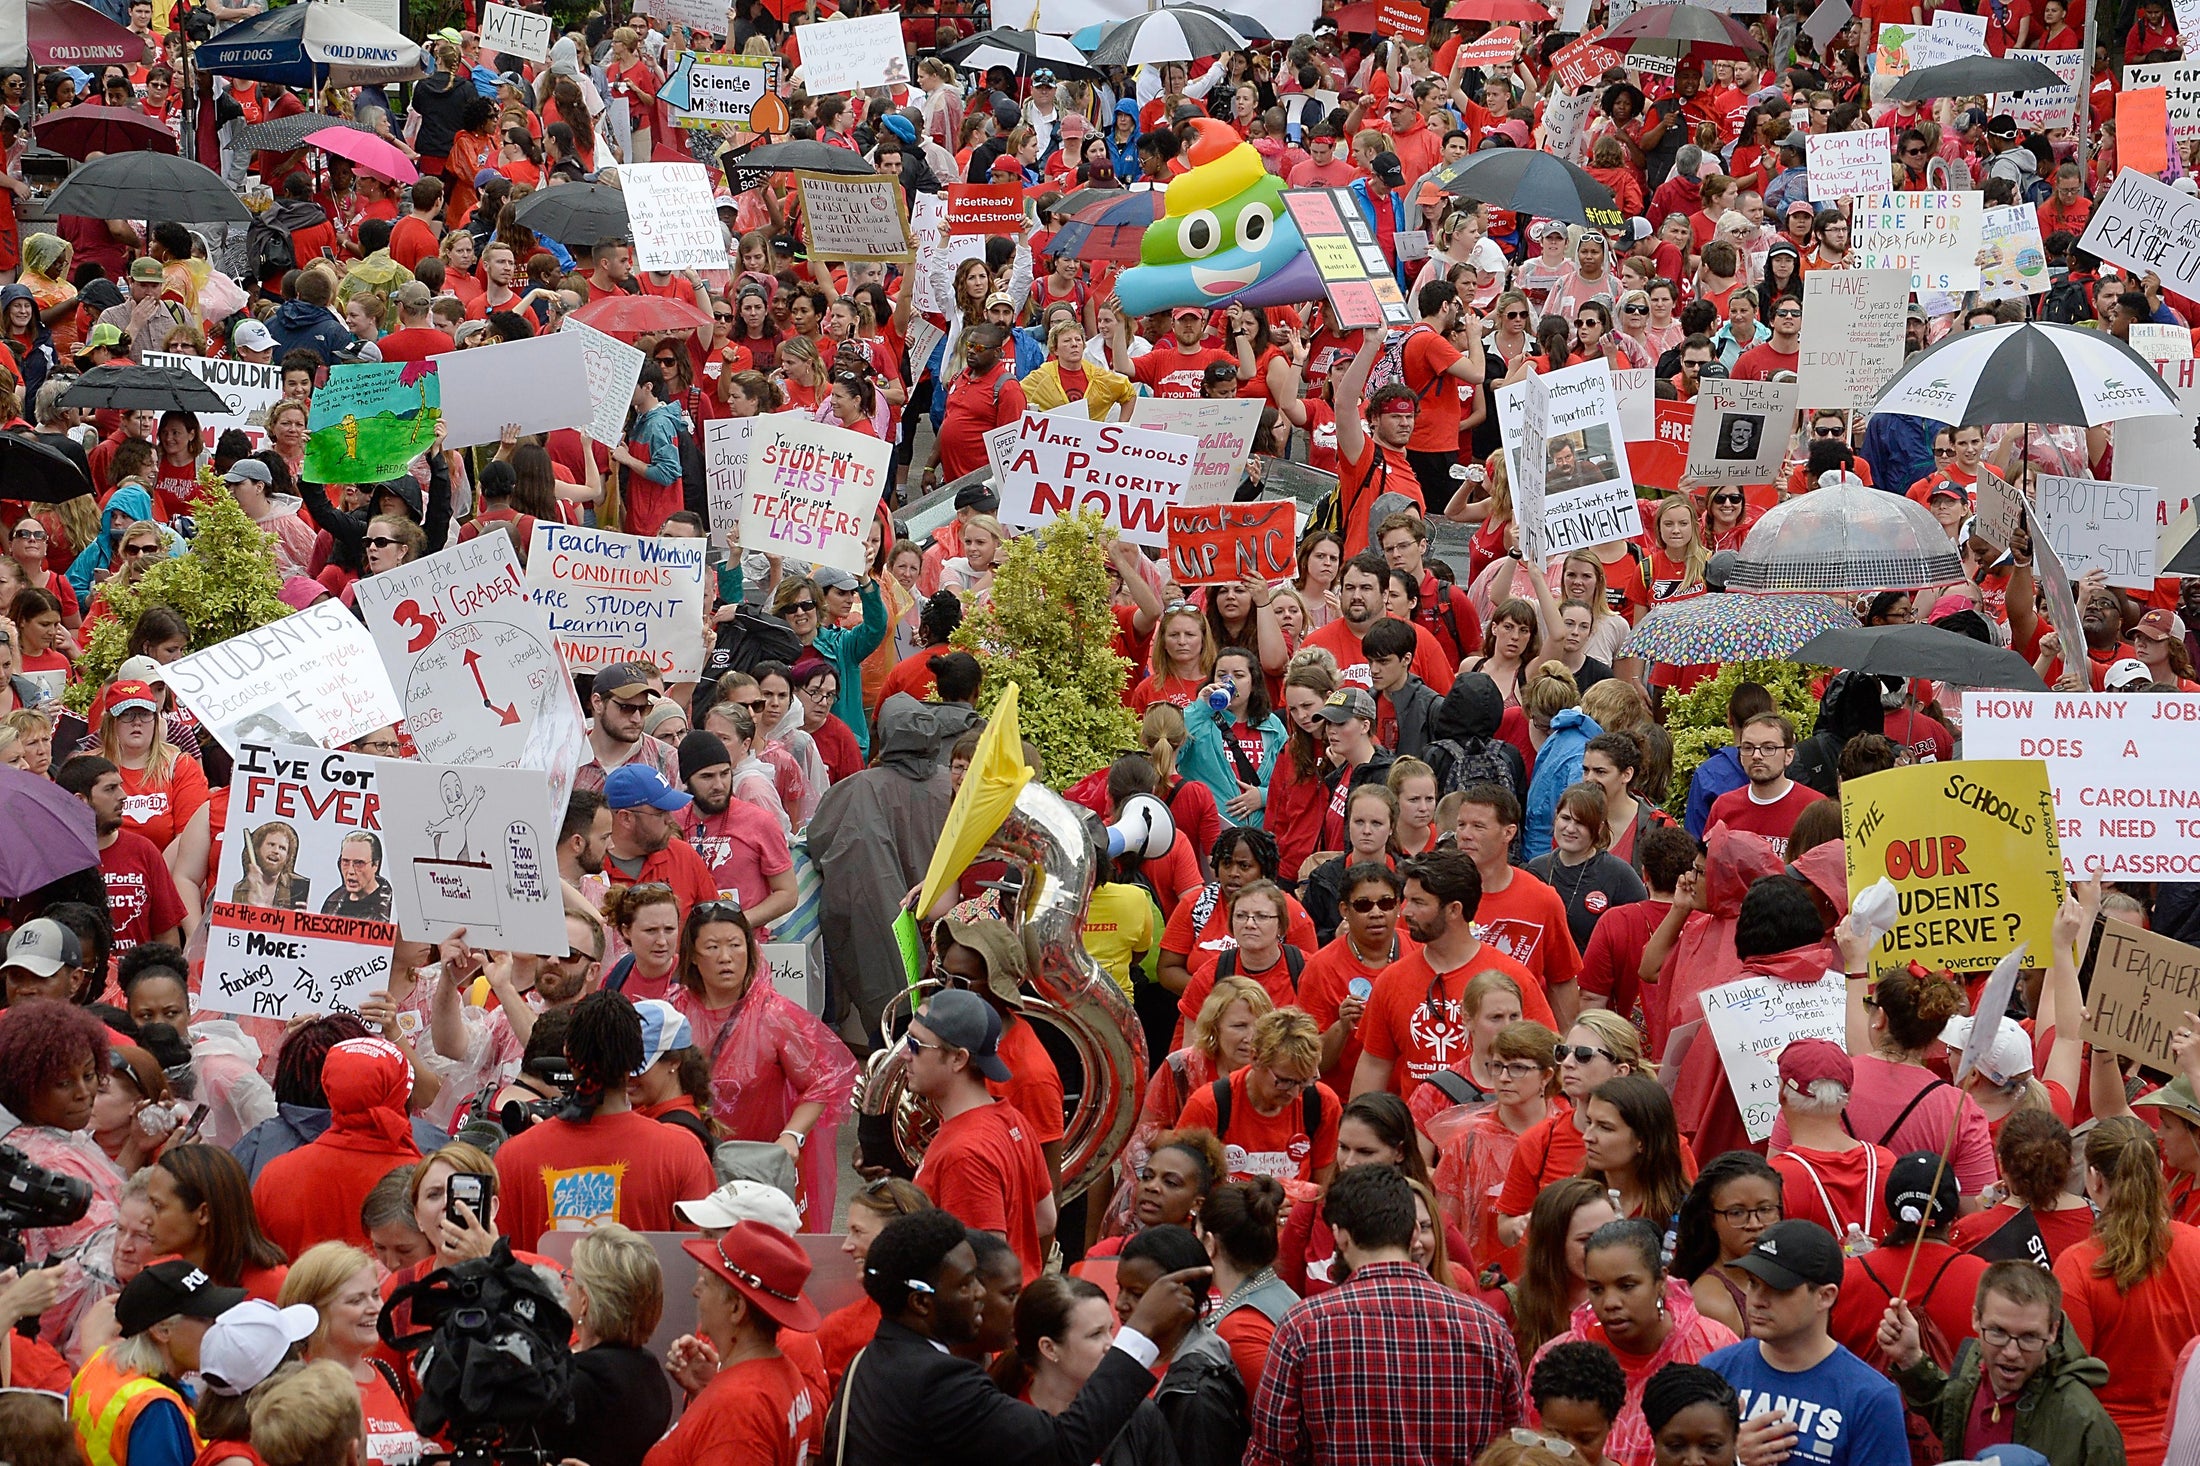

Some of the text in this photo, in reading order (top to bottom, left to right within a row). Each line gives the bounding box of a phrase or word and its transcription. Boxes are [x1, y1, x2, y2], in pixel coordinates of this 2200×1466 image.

[489, 8, 548, 40] WTF?
[1383, 5, 1422, 23] #GetReady
[843, 20, 892, 36] Professor
[1378, 15, 1425, 36] #NCAEStrong
[50, 45, 124, 59] COLD DRINKS
[219, 48, 273, 62] HOT DOGS
[323, 44, 398, 62] COLD DRINKS
[1462, 49, 1515, 59] #NCAEStrong
[2055, 54, 2080, 65] JUDGE
[808, 63, 830, 76] had
[1558, 53, 1616, 88] HAVE JOB
[2130, 69, 2161, 84] You
[2034, 97, 2054, 106] YEAR
[2001, 108, 2067, 122] CLASSROOM
[1807, 133, 1888, 154] I can afford
[1818, 153, 1876, 167] to teach
[621, 165, 705, 184] Your CHILD
[1809, 169, 1855, 181] because
[651, 190, 713, 206] TEACHER
[835, 183, 887, 194] CAROLINA
[1817, 180, 1858, 196] husband
[955, 198, 1014, 207] #GetReady
[1855, 194, 1962, 209] TEACHERS
[2112, 178, 2168, 220] NORTH
[637, 215, 721, 236] 3 LIVE
[842, 214, 861, 224] TAX
[950, 212, 1022, 223] #NCAEStrong
[1585, 207, 1624, 225] #ForOur
[1854, 214, 1960, 230] HERE FOR
[652, 230, 715, 246] #TIRED
[2139, 219, 2196, 249] C'MON AND
[1852, 254, 1920, 270] GRADE
[1809, 277, 1870, 296] I HAVE:
[1870, 295, 1905, 312] years of
[1859, 311, 1899, 321] experience
[1883, 320, 1904, 332] degree
[1803, 350, 1885, 366] I DON'T have:
[201, 360, 282, 390] WOULDN'T
[1858, 366, 1894, 378] cell phone
[1704, 379, 1780, 399] I'm Just a
[1847, 383, 1873, 394] money
[1906, 386, 1957, 402] LACOSTE
[2094, 387, 2147, 402] LACOSTE
[1551, 397, 1605, 427] important?
[1713, 396, 1737, 411] Poe
[709, 424, 730, 442] I
[774, 432, 853, 464] You can't put
[1096, 426, 1189, 467] SCHOOLS
[762, 445, 876, 488] STUDENTS
[1010, 449, 1182, 496] A PRIORITY
[1689, 464, 1751, 479] Nobody Funds
[773, 466, 845, 497] FIRST
[711, 496, 733, 511] the
[780, 488, 833, 512] if you put
[1616, 488, 1630, 500] the
[2043, 478, 2152, 522] PROTEST
[752, 493, 862, 537] TEACHERS
[1029, 481, 1178, 533] NOW
[769, 517, 833, 550] LAST
[538, 525, 702, 583] Teacher Working
[1175, 528, 1291, 579] UP NC
[2098, 543, 2153, 577] SINE
[359, 536, 507, 609] A Day in the Life of
[552, 554, 673, 587] CONDITIONS
[392, 562, 530, 654] 3rd GRADER!
[494, 627, 519, 647] DAZE
[549, 612, 648, 649] Learning
[170, 604, 353, 694] STUDENTS,
[196, 658, 321, 722] Because you are
[286, 673, 358, 714] I walk
[318, 706, 343, 725] the
[1976, 699, 2128, 720] HOW MANY
[2020, 738, 2139, 759] DOES A
[238, 743, 375, 790] I'VE GOT
[246, 776, 382, 831] FEVER
[1855, 775, 2036, 848] THE SCHOOLS
[2038, 790, 2059, 850] poverty
[2100, 819, 2157, 839] NEED
[510, 846, 533, 860] 7,000
[1885, 835, 1971, 881] OUR
[429, 871, 463, 887] Teacher's
[519, 880, 535, 889] LOST
[441, 886, 471, 900] Assistant
[1898, 882, 2000, 917] UDENTS
[213, 904, 396, 942] and the only PRESCRIPTION
[227, 931, 307, 960] is MORE:
[218, 955, 388, 1004] funding TA's SUPPLIES
[252, 990, 288, 1017] PAY
[1708, 985, 1769, 1012] A higher
[1759, 996, 1819, 1018] 3rd graders
[1752, 1026, 1834, 1052] more pressure
[2094, 993, 2179, 1065] HUMAN
[1407, 1060, 1436, 1071] Special
[1739, 1389, 1843, 1441] IANTS
